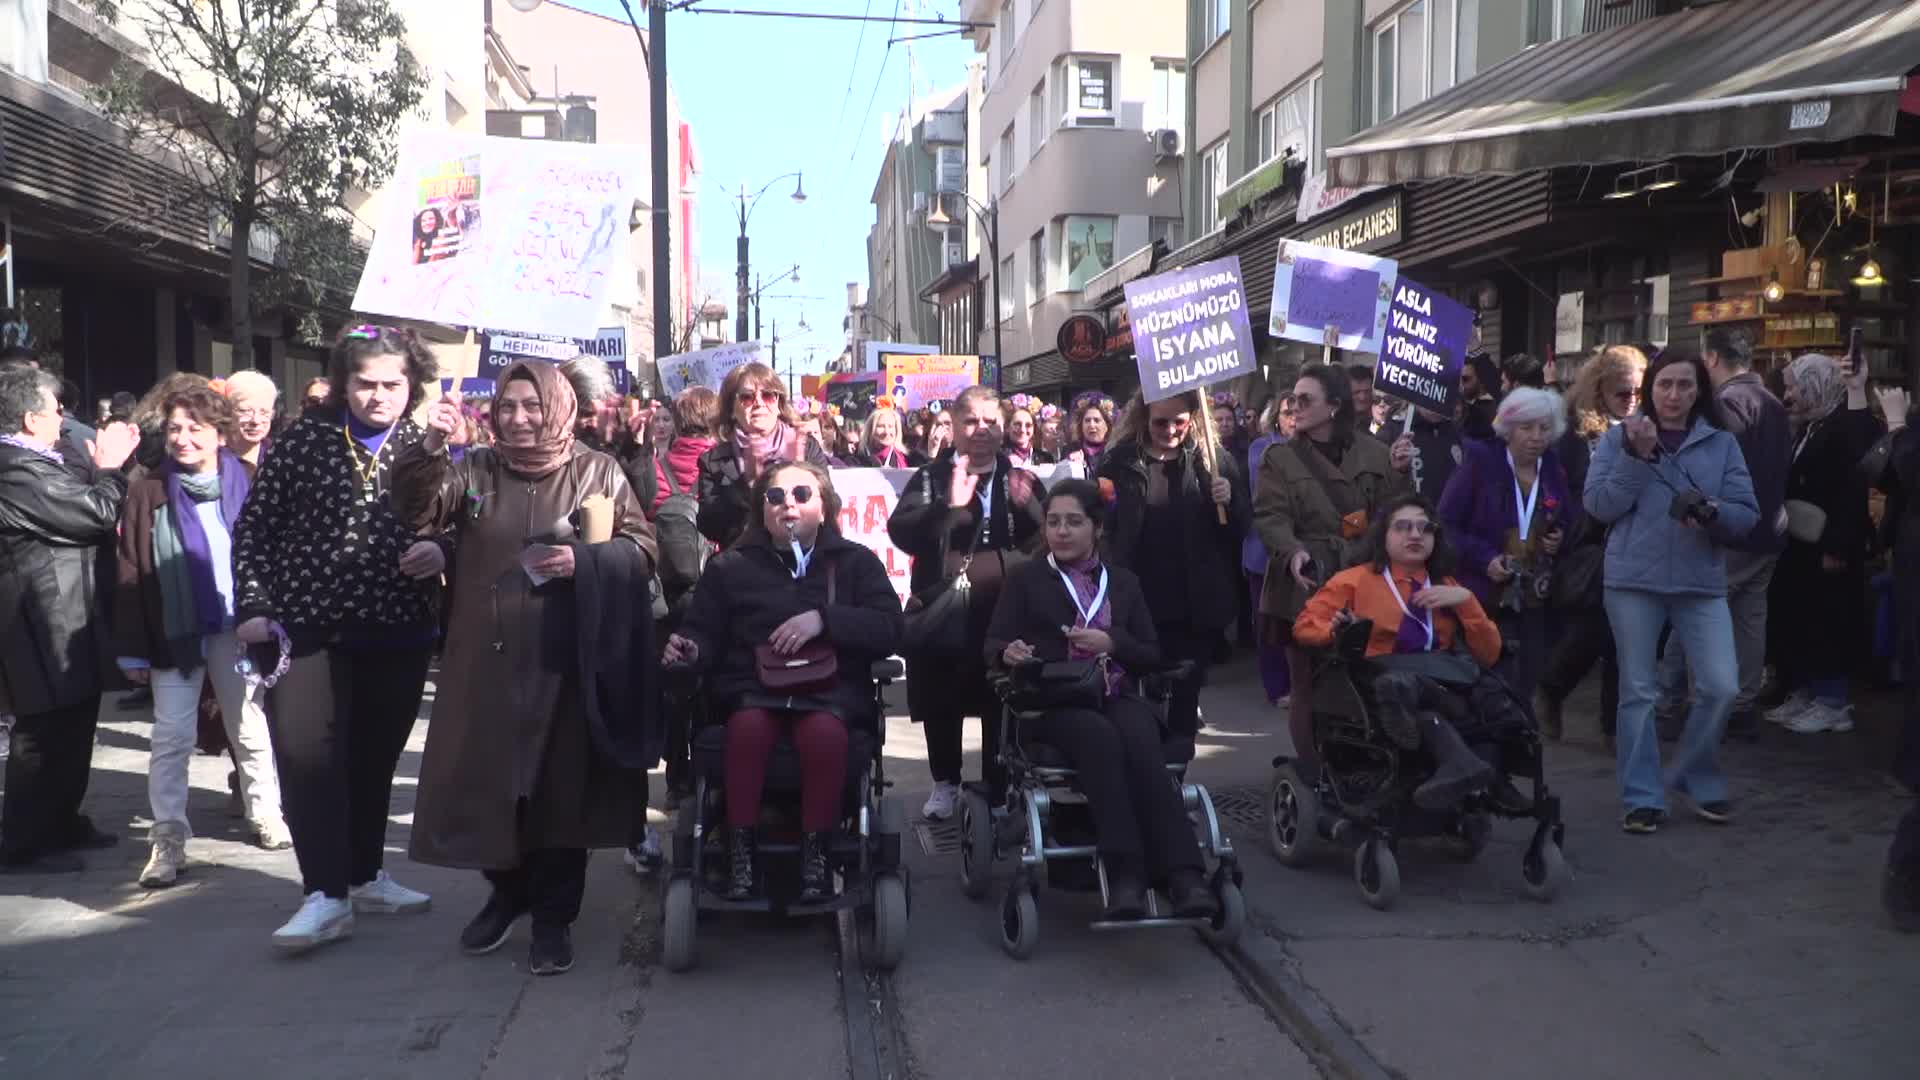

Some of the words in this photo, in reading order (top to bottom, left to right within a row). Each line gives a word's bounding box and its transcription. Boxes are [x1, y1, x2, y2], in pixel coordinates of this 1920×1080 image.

[1343, 199, 1397, 249] ECZANESİ
[1131, 280, 1198, 309] SOKAKLARI
[1199, 271, 1238, 291] MORA,
[1395, 285, 1432, 316] ASLA
[1135, 289, 1241, 336] HÜZNÜMÜZÜ
[1392, 309, 1438, 344] YALNIZ
[1157, 349, 1240, 389] BULADIK!
[1387, 335, 1444, 374] YÜRÜME-
[1381, 361, 1447, 403] YECEKSİN!
